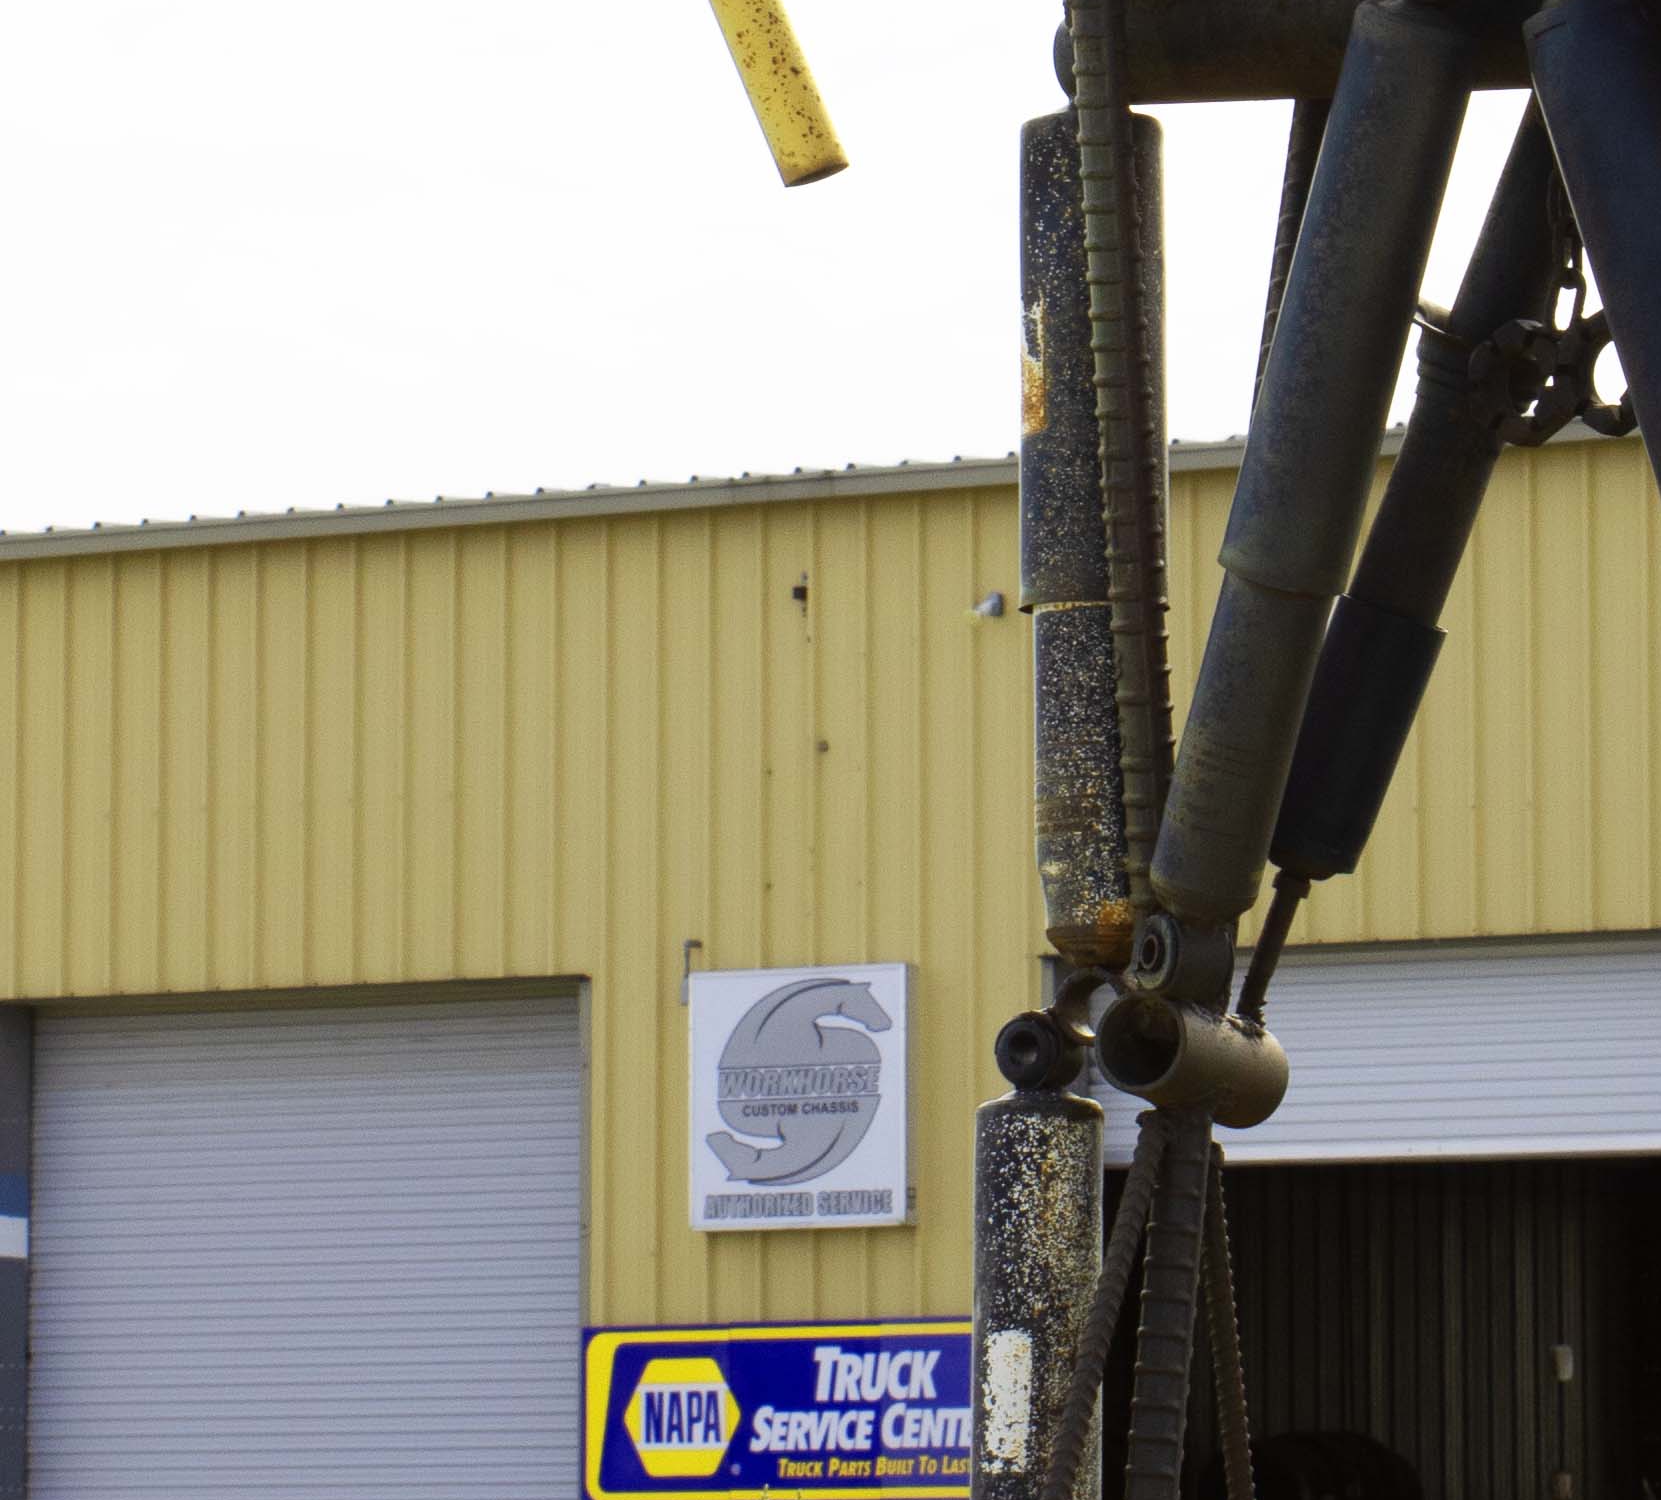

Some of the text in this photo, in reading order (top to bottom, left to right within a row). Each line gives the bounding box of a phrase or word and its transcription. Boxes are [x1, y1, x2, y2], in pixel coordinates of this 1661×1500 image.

[719, 1066, 881, 1099] WORKHORSE
[742, 1101, 859, 1117] CUSTOM CHASSIS
[704, 1190, 893, 1219] AUTHORIZED SERVICE
[813, 1346, 941, 1402] TRUCK
[644, 1390, 721, 1443] NAPA
[750, 1402, 973, 1452] SERVICE CENTE
[778, 1458, 823, 1478] TRUCK
[828, 1457, 871, 1477] PARTS
[875, 1456, 914, 1476] BUILT
[919, 1455, 937, 1475] TO
